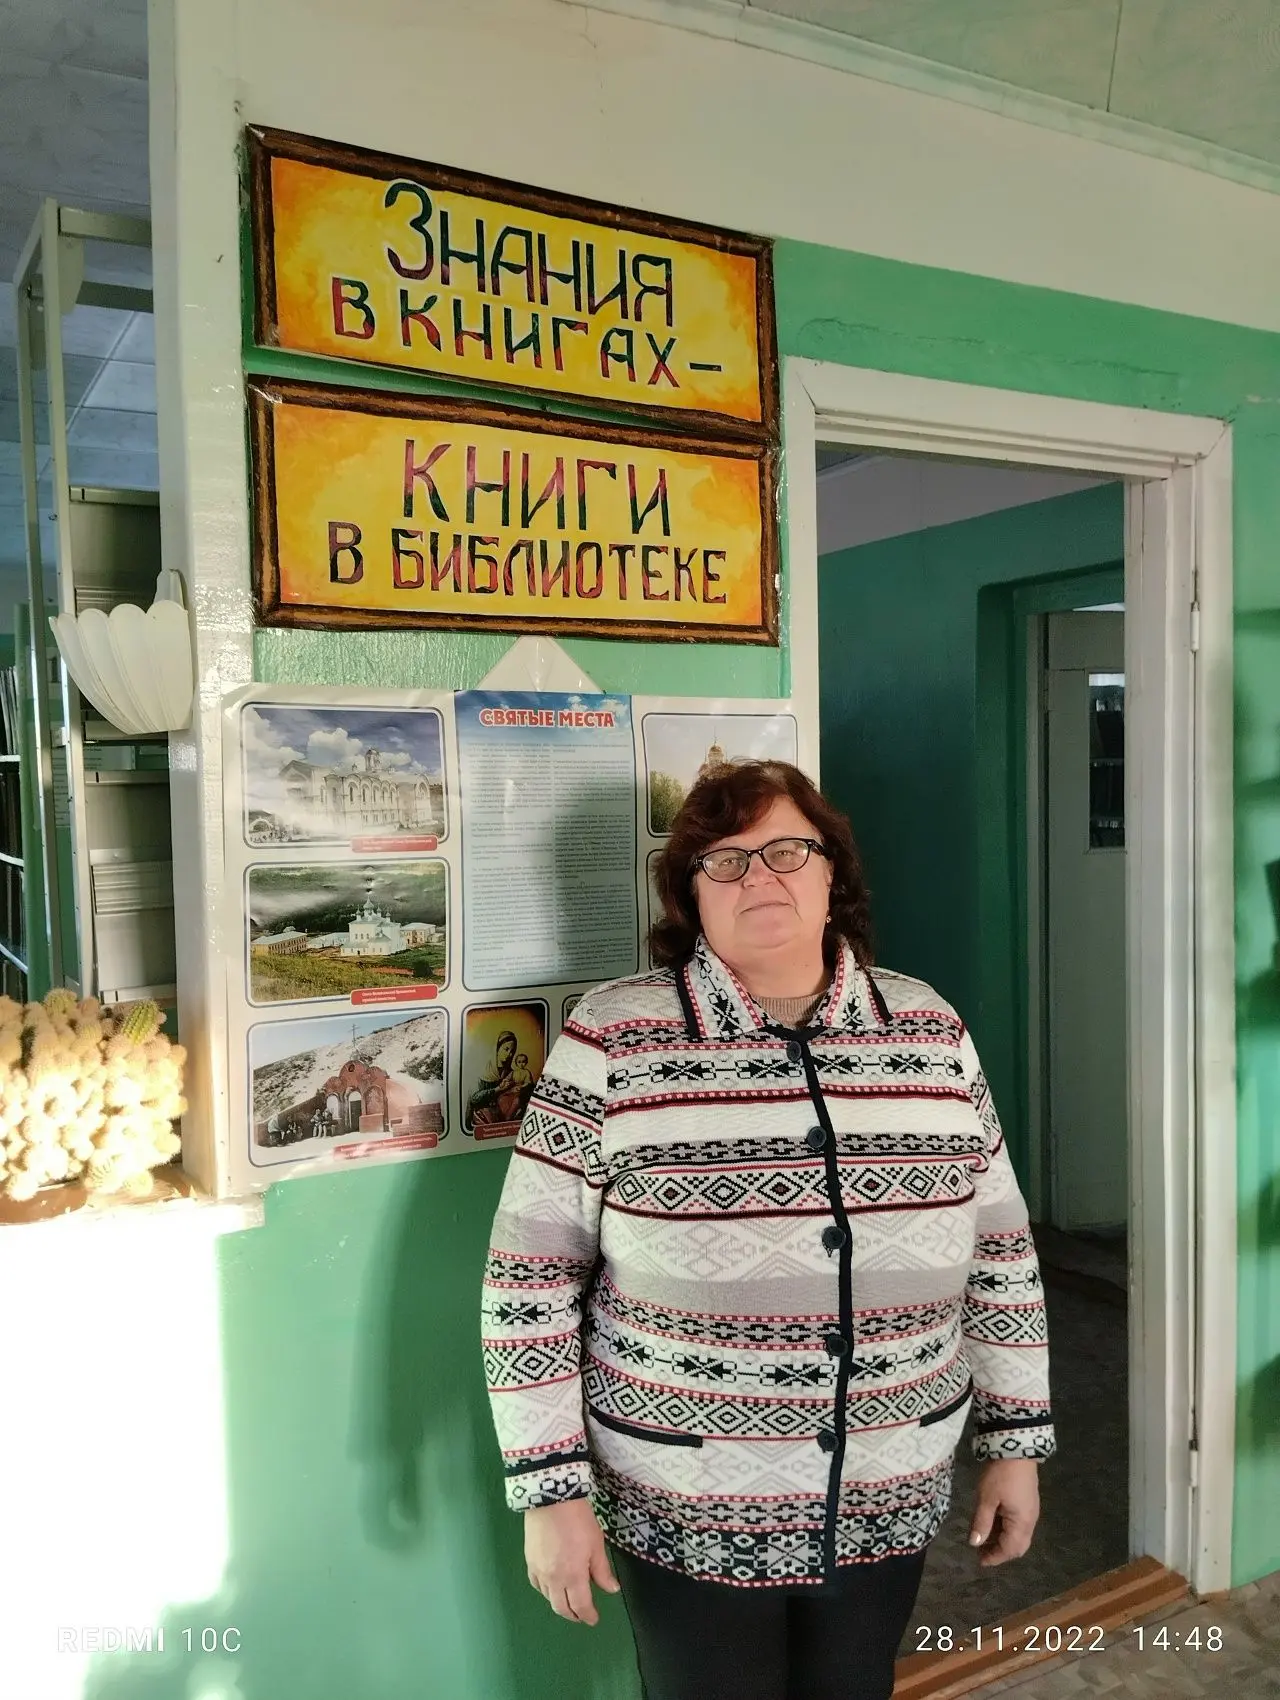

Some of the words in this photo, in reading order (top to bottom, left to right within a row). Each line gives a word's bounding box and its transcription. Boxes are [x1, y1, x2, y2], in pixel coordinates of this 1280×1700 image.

[385, 181, 673, 327] ЗНАНИЯ
[331, 276, 375, 340] В
[403, 439, 671, 536] КНИГИ
[328, 521, 363, 583] В
[391, 528, 727, 605] БИБЛИОТЕКЕ
[480, 709, 554, 727] СВЯТЫЕ
[558, 711, 615, 728] МЕСТА
